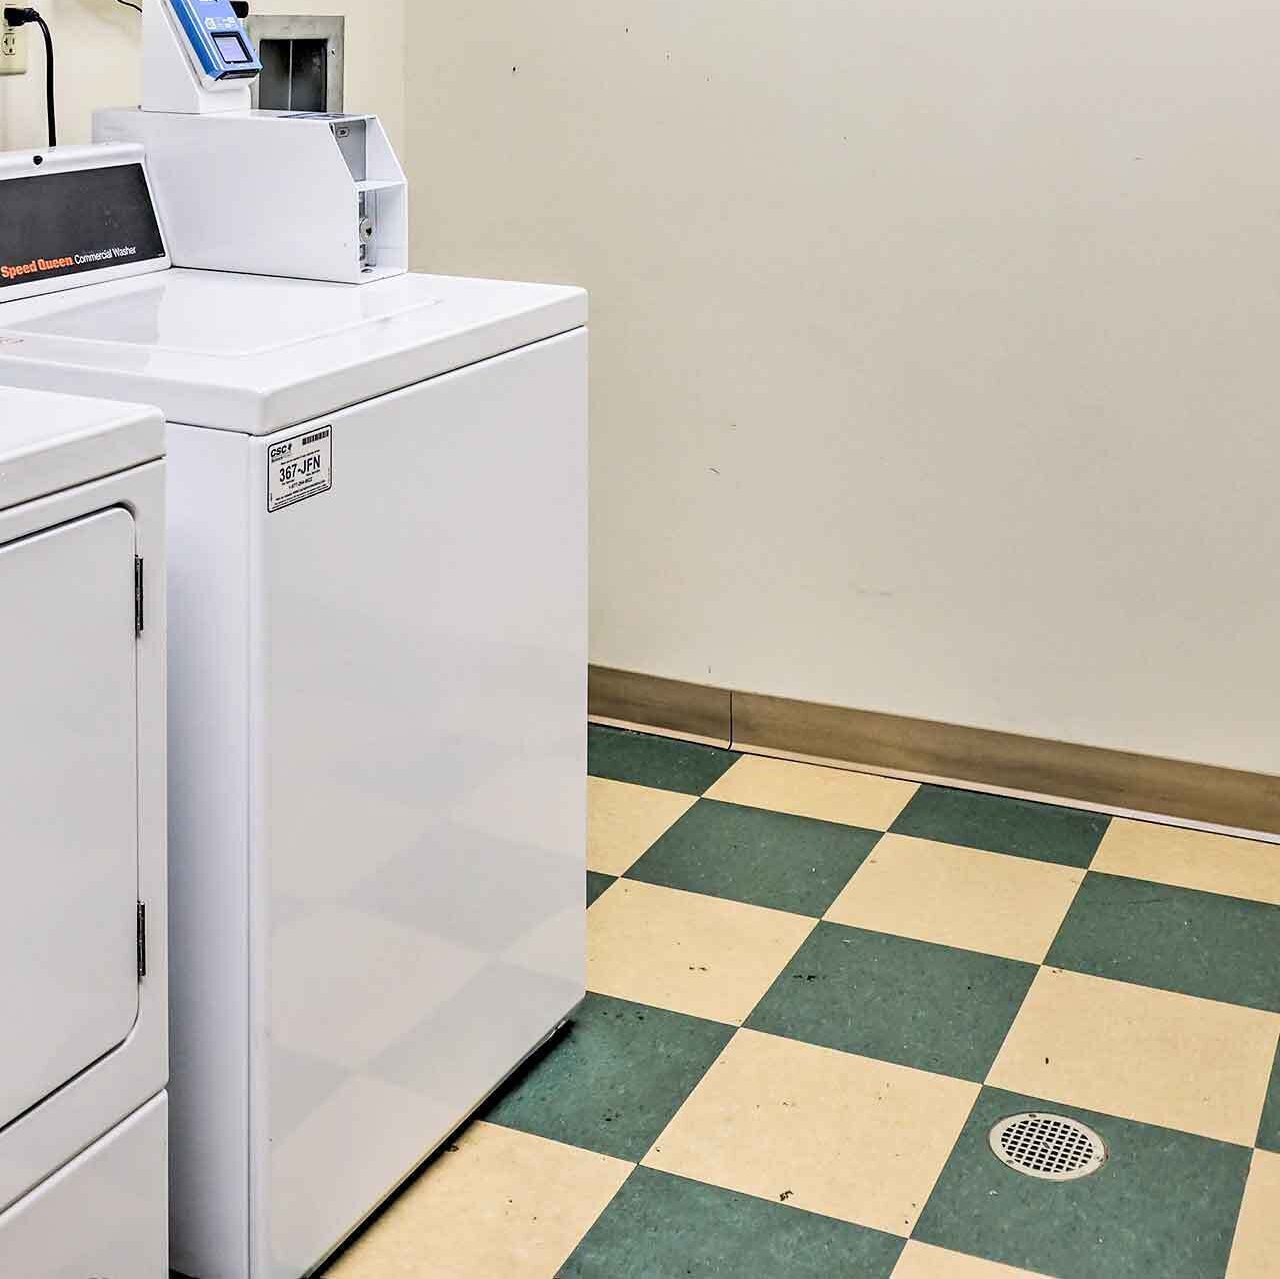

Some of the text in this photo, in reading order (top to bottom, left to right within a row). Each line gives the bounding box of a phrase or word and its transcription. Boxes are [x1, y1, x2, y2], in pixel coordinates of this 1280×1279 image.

[1, 246, 136, 279] Speed Queen Commercial Washer
[271, 445, 287, 457] CSC
[280, 455, 320, 482] 367-JFN
